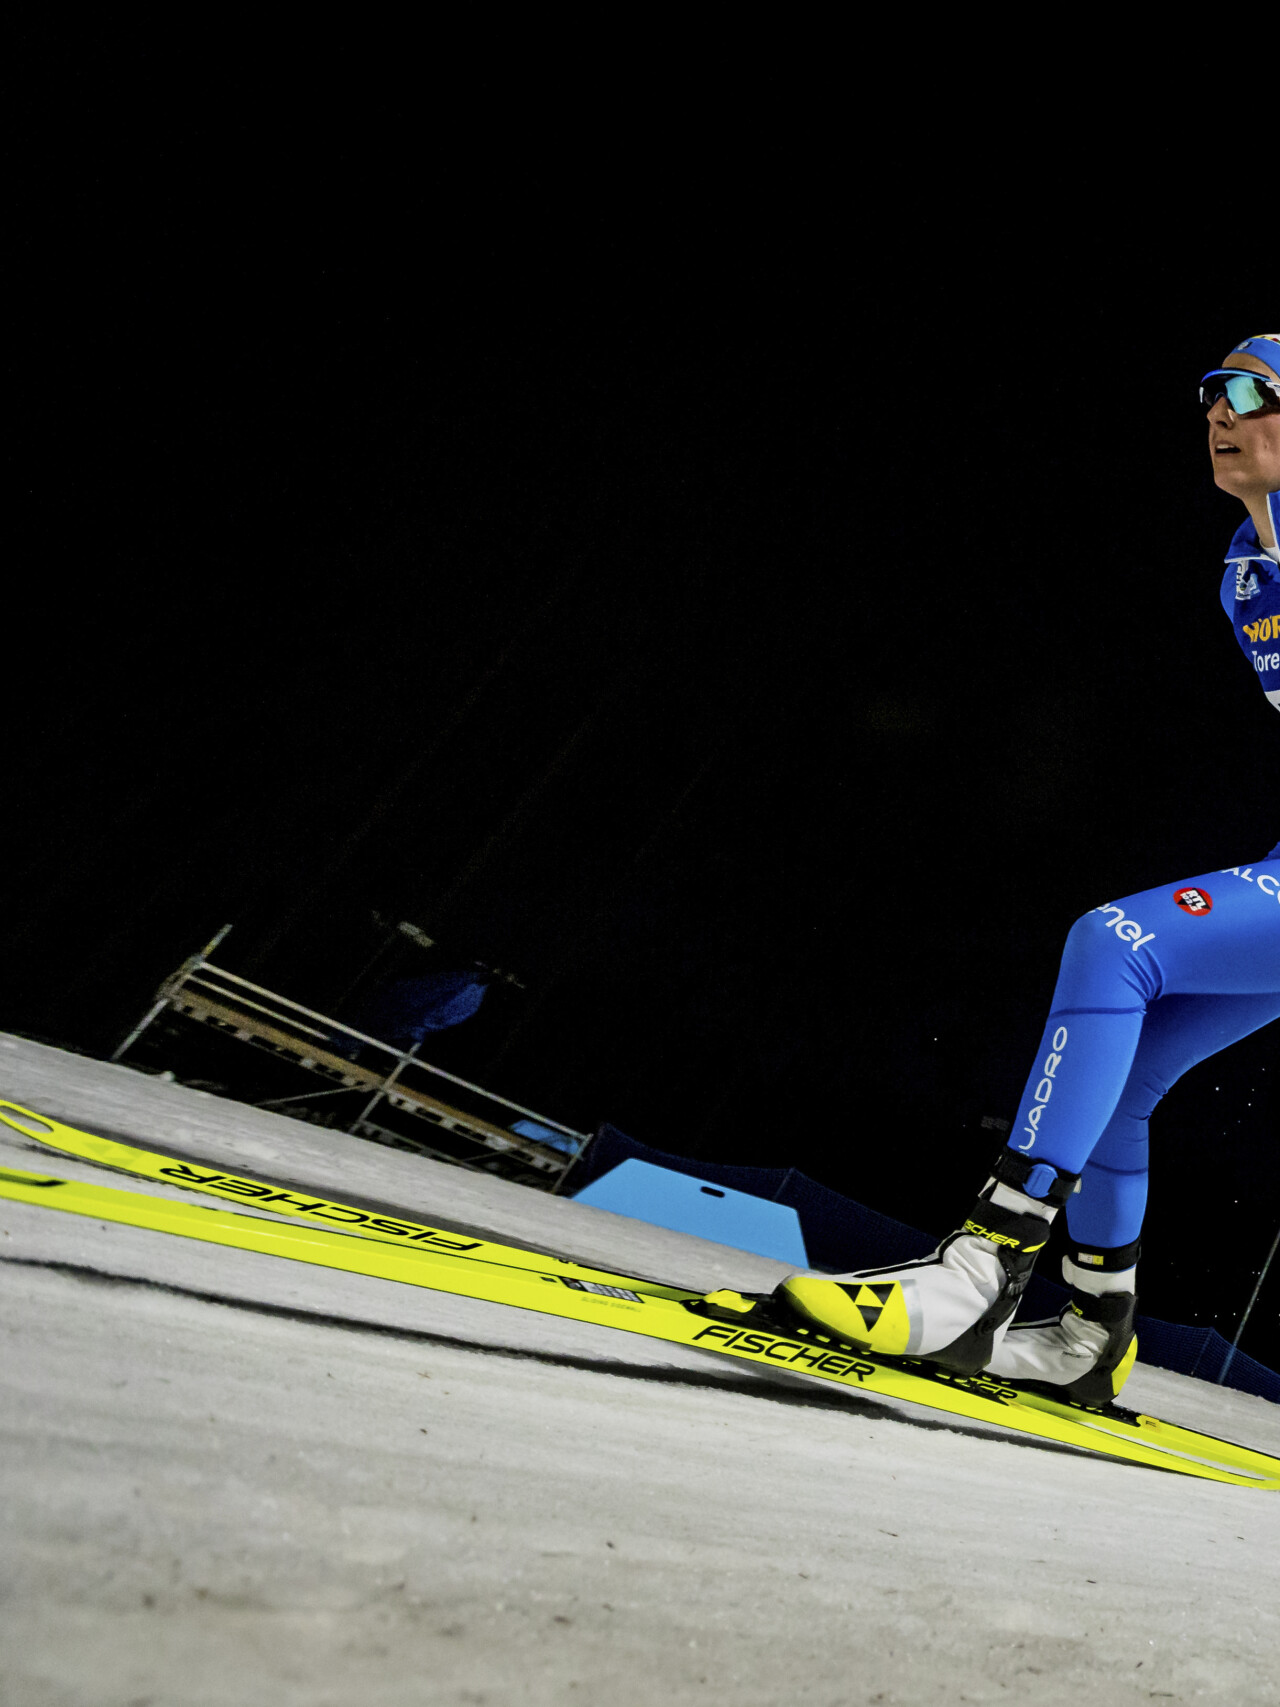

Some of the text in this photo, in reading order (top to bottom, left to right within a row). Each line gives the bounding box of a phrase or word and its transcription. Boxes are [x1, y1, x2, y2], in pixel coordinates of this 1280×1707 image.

[1018, 1026, 1068, 1156] UADRO
[159, 1164, 484, 1251] FISCHER
[692, 1325, 876, 1382] FISCHER
